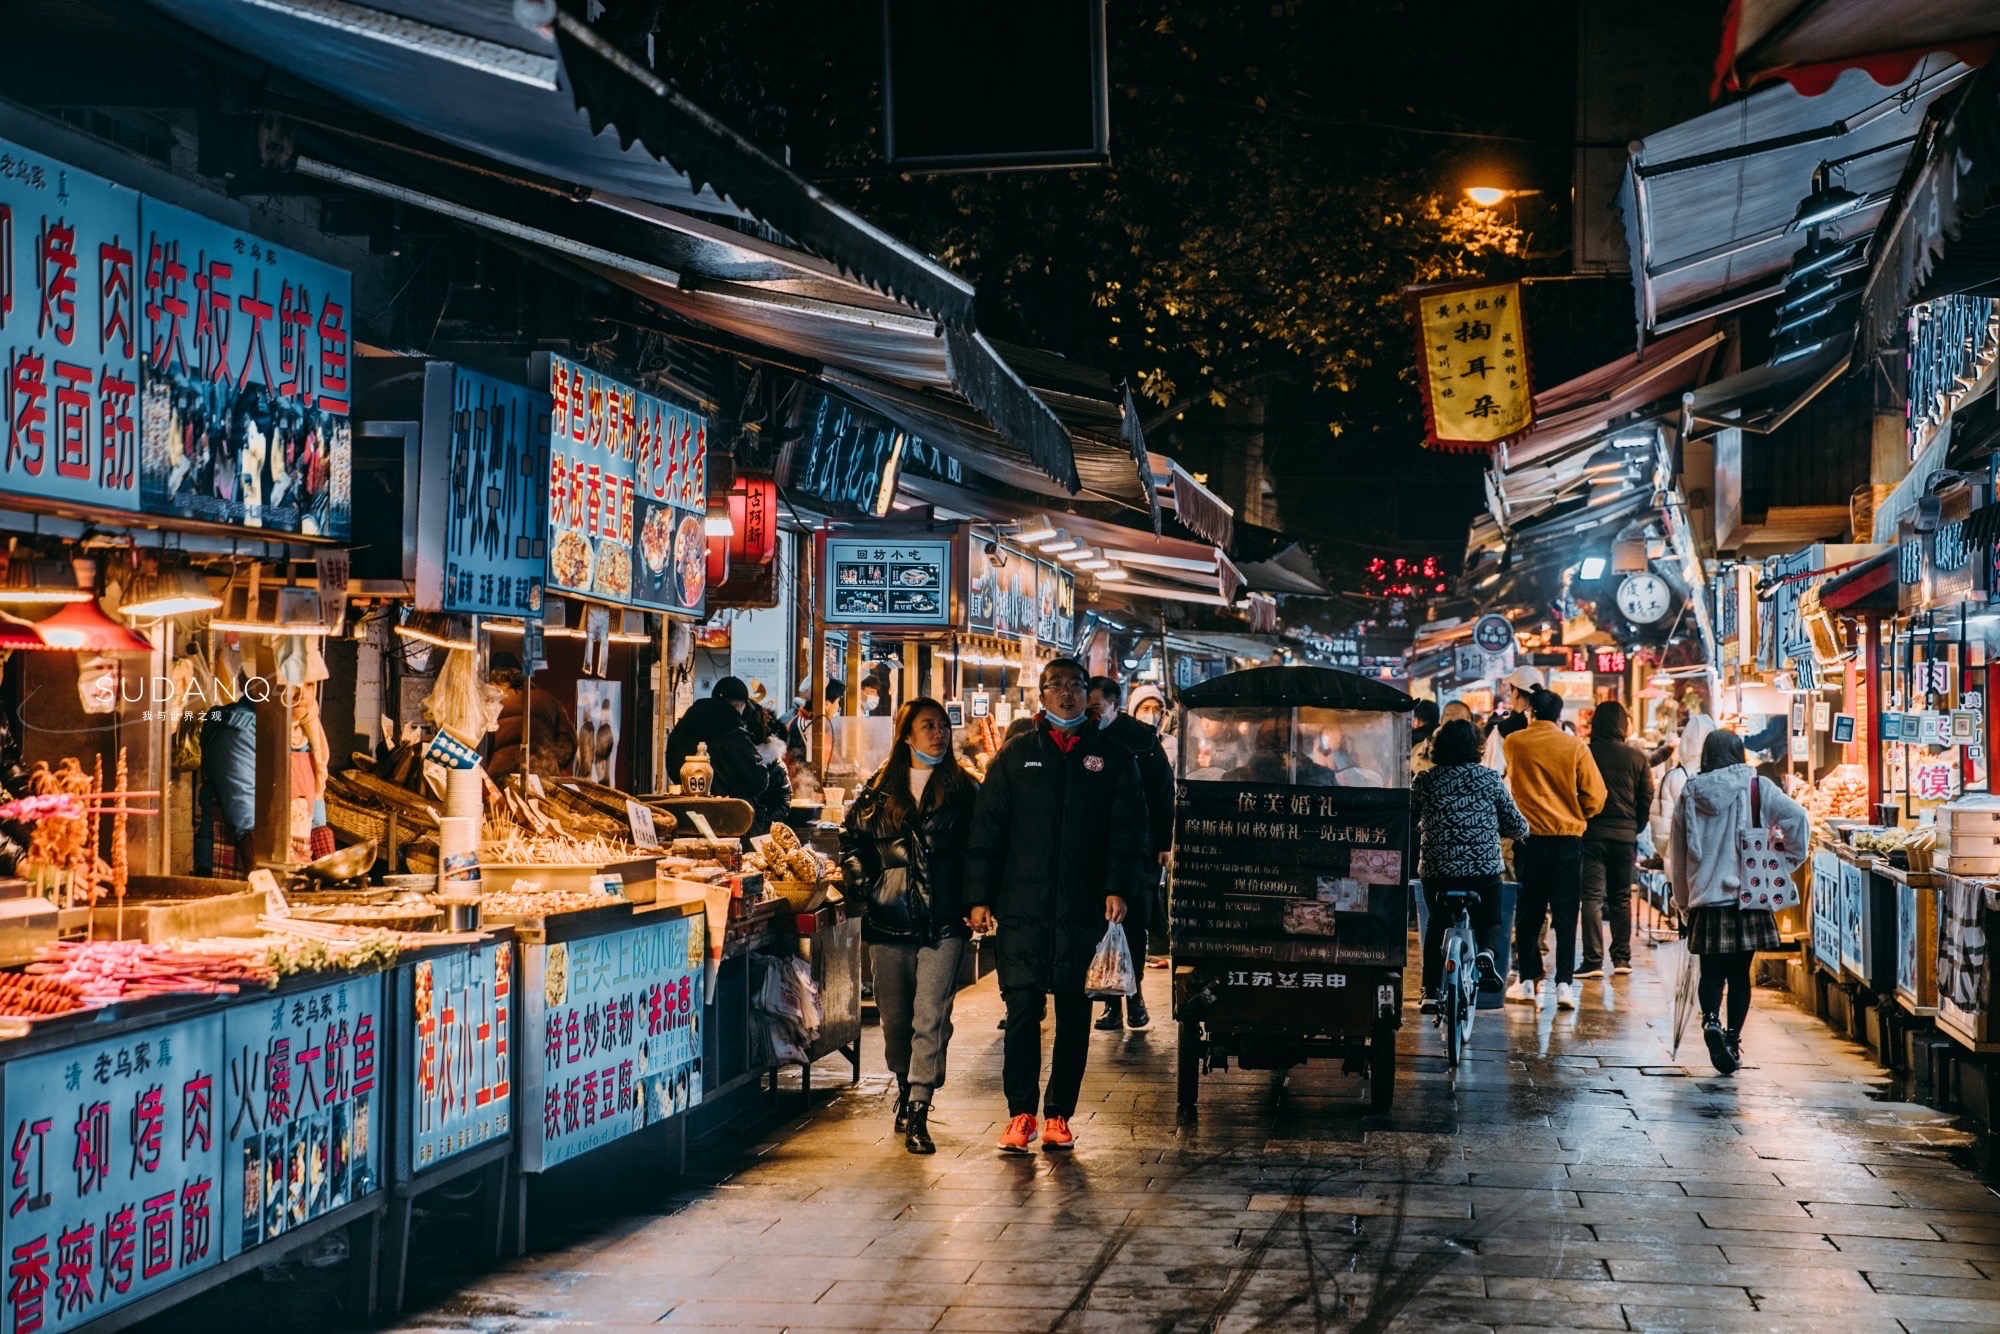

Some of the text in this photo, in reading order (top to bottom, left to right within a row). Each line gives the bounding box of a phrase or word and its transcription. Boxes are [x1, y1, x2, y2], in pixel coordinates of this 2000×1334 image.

[0, 204, 135, 360] 烤肉
[145, 230, 351, 415] 铁板大鱿鱼
[551, 357, 636, 463] 特色炒凉粉
[1454, 320, 1501, 419] 掏耳朵
[5, 345, 136, 491] 烤面筋
[550, 451, 634, 550] 铁板香豆腐
[857, 549, 922, 561] 回坊小吃
[1184, 819, 1388, 844] 穆斯林风格婚礼一站式服务
[572, 923, 684, 995] 舌尖上的小吃
[1228, 971, 1347, 988] 江苏 宗申
[291, 992, 333, 1028] 老乌家
[544, 991, 635, 1072] 特色炒凉粉
[649, 975, 691, 1037] 关东煮
[64, 1036, 173, 1092] 清 老乌家 真
[230, 1011, 376, 1142] 火爆大鱿鱼
[544, 1057, 634, 1142] 铁板香豆腐
[10, 1069, 213, 1218] 红柳烤肉
[9, 1174, 212, 1334] 香辣烤面筋
